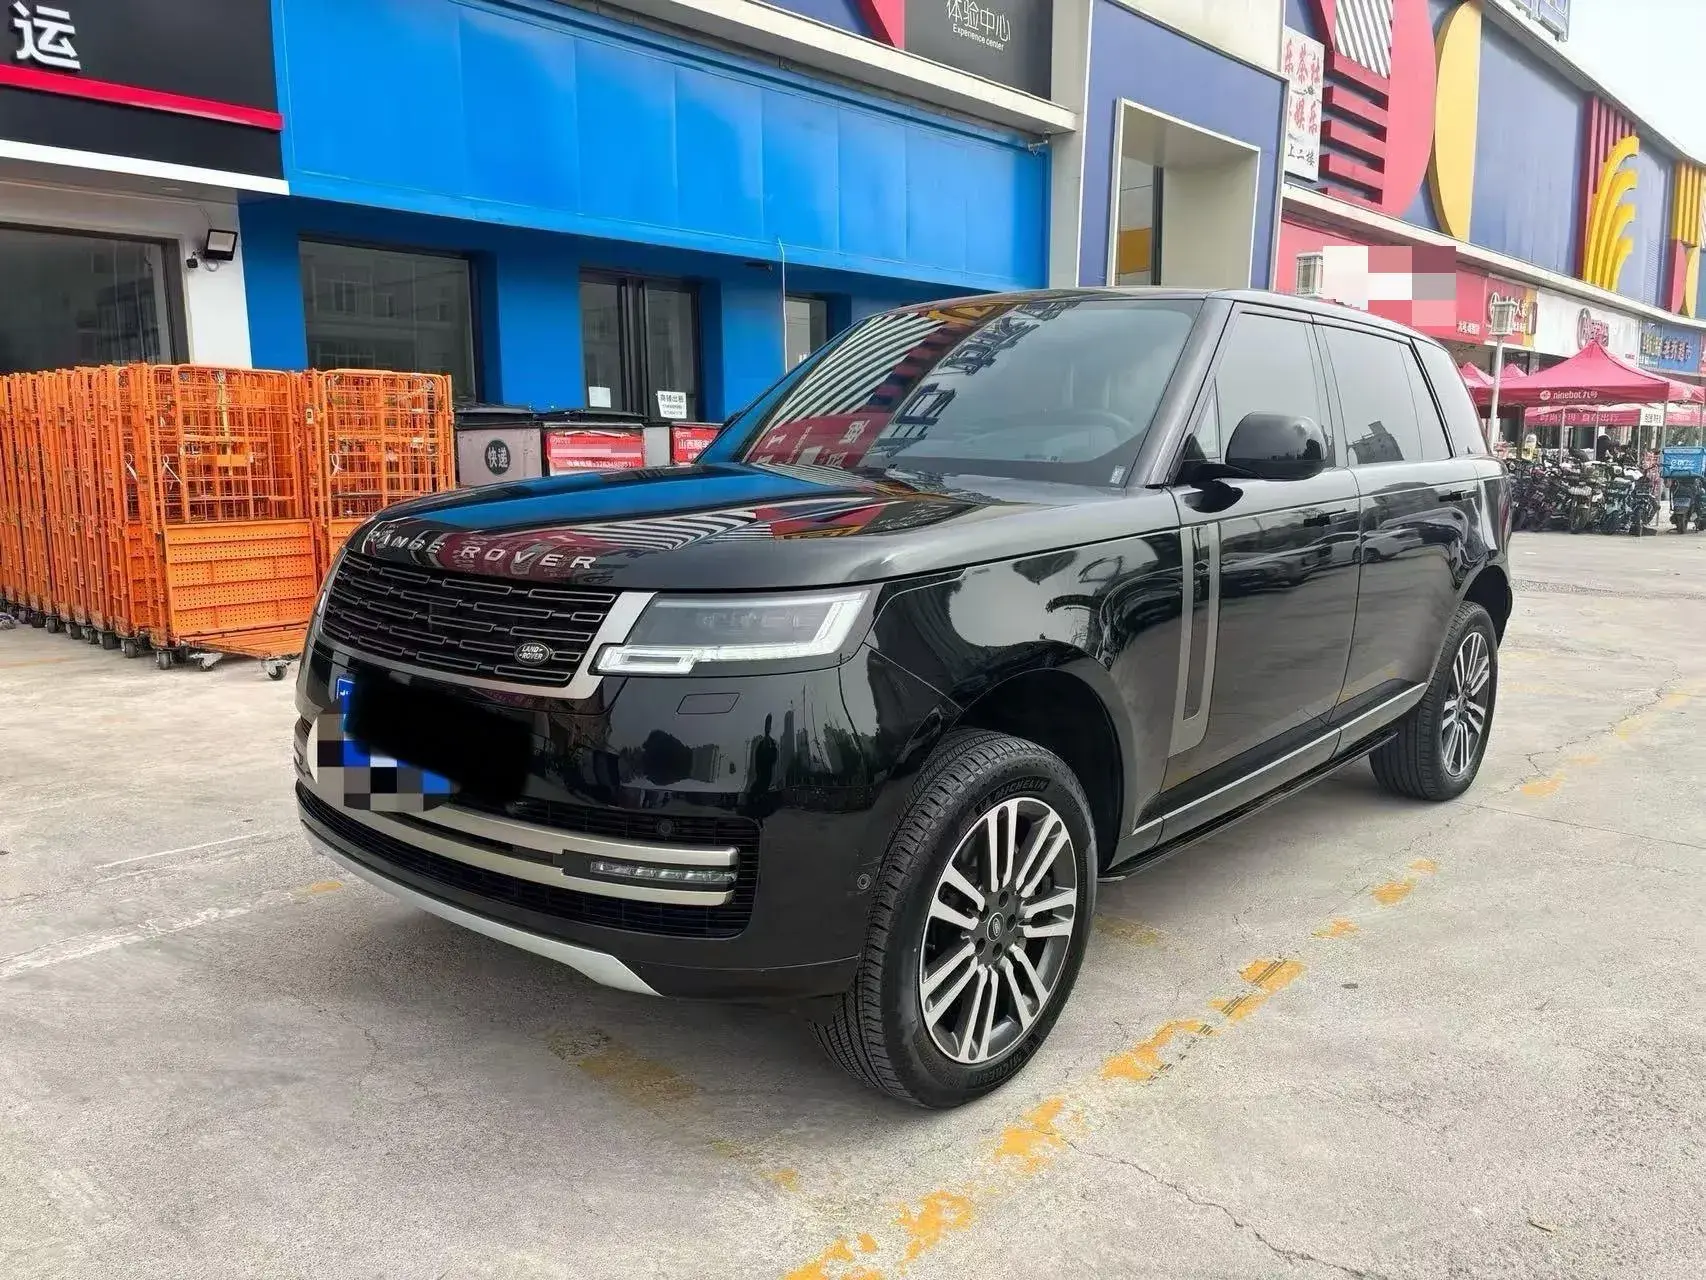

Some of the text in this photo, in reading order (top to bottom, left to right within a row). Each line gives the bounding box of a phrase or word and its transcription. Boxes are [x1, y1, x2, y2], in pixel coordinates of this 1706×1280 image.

[945, 0, 1012, 42] 体验中心
[12, 0, 81, 70] 运
[952, 23, 1005, 52] Experience center
[1553, 390, 1582, 399] ninebot
[488, 446, 508, 468] 快递
[366, 529, 597, 570] RANGE ROVER
[521, 645, 540, 653] LAND
[521, 652, 544, 660] ROVER
